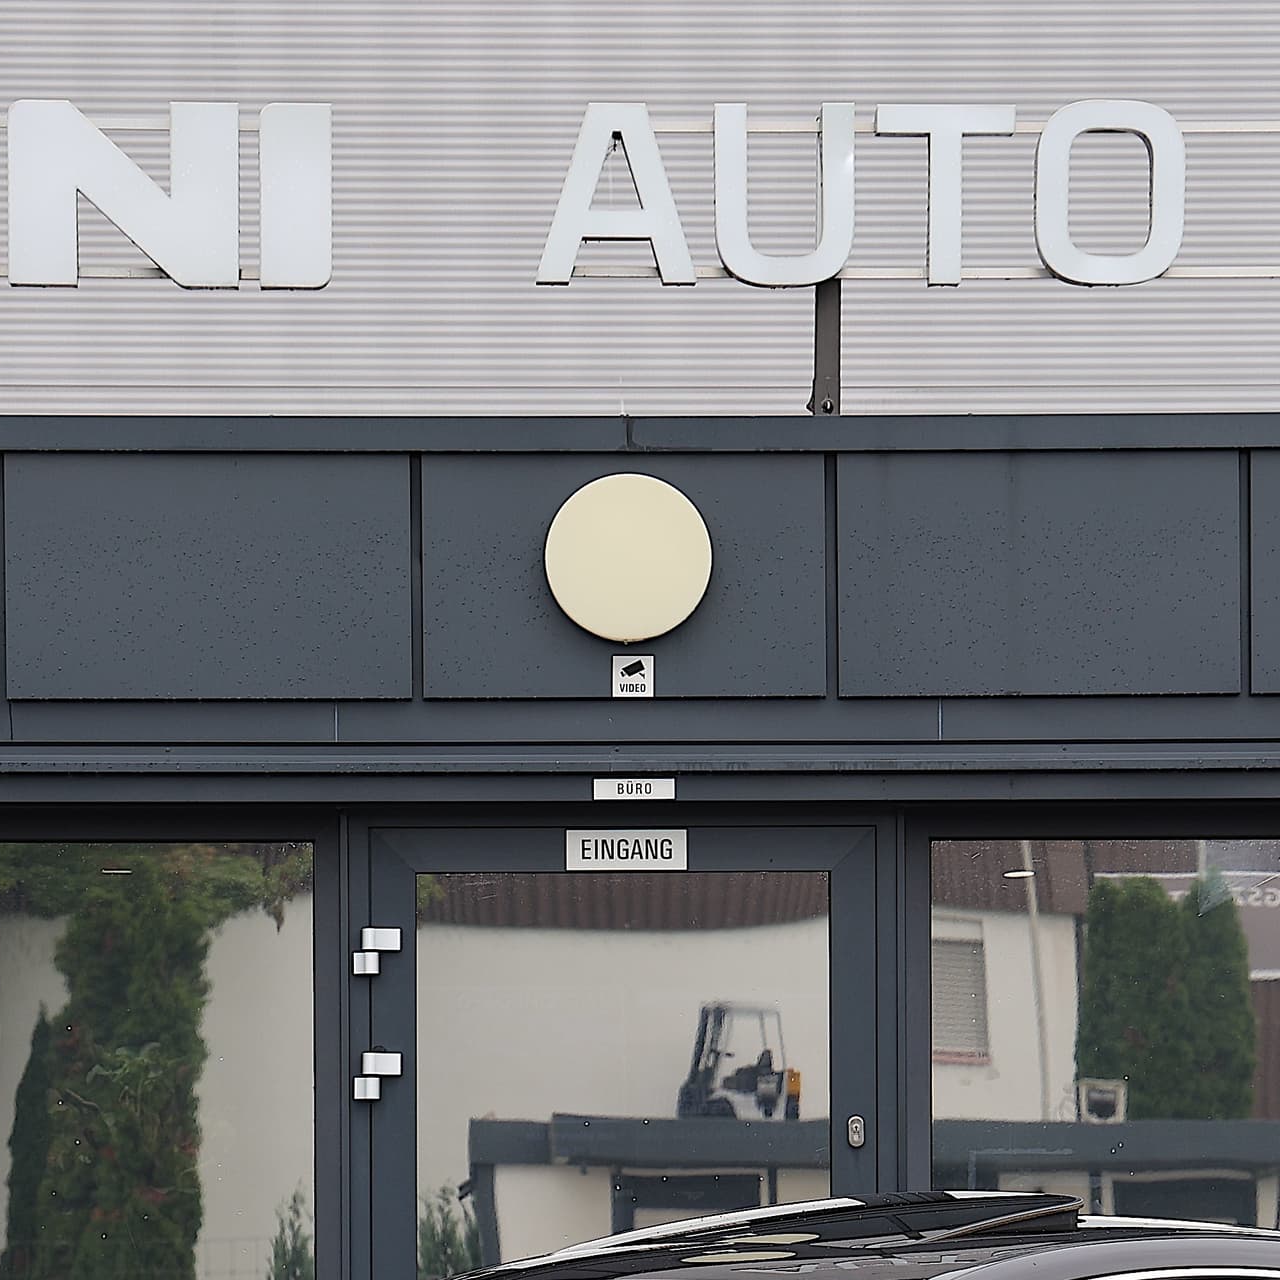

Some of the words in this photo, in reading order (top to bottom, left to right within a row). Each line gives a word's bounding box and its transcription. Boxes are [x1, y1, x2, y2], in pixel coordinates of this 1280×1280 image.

[535, 97, 1187, 288] AUTO
[619, 683, 646, 693] VIDEO
[617, 780, 652, 795] BÜRO
[581, 838, 673, 860] EINGANG
